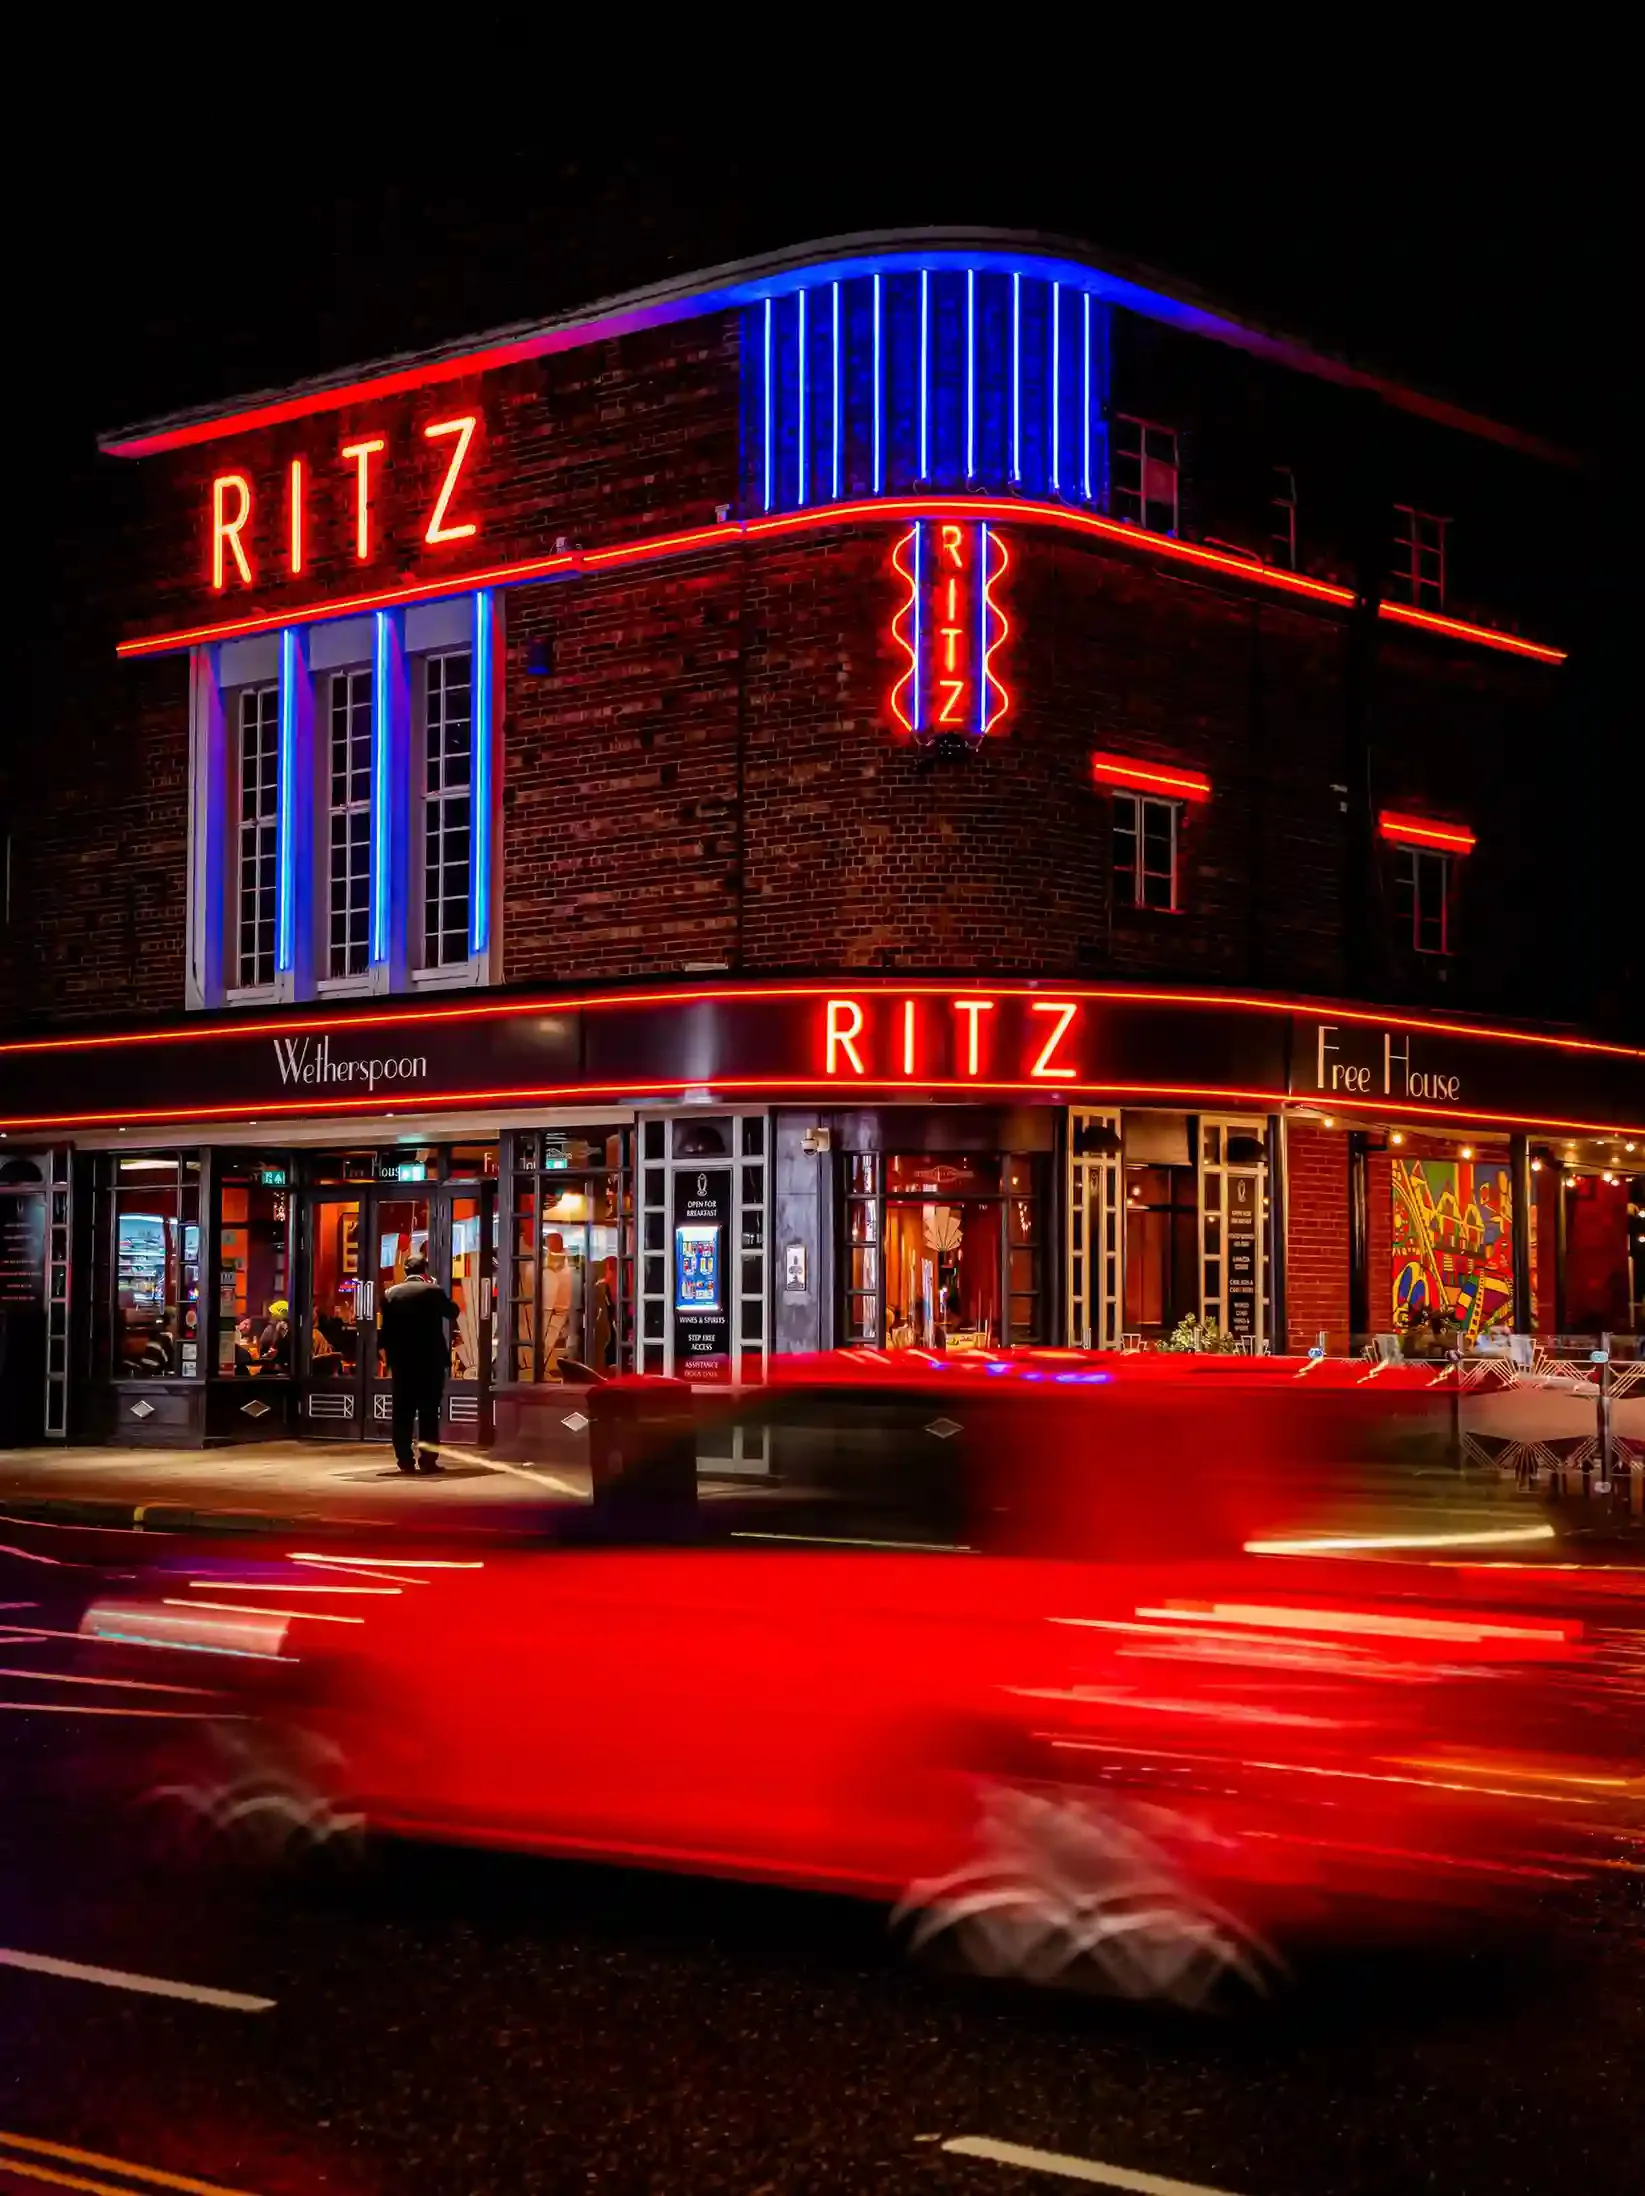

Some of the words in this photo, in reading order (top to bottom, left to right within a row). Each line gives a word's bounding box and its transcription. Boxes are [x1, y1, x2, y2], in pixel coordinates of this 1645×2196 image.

[212, 415, 477, 589] RITZ
[939, 525, 964, 722] RITZ
[273, 1034, 427, 1092] Wetherspoon
[824, 999, 1078, 1078] RITZ
[1317, 1025, 1371, 1093] Free
[1383, 1032, 1460, 1101] House
[687, 1200, 703, 1208] OPEN
[690, 1343, 712, 1351] ACCESS
